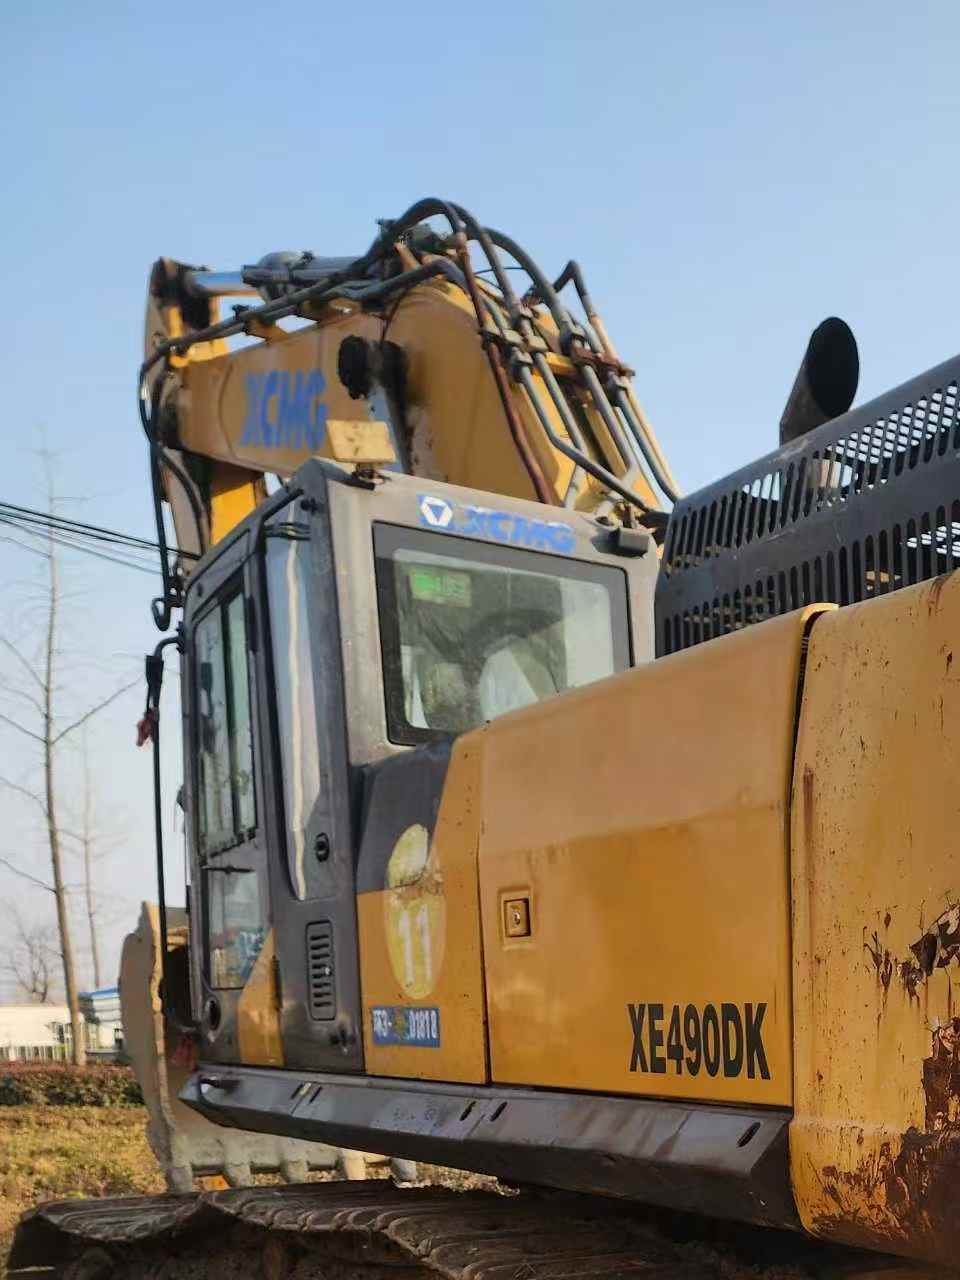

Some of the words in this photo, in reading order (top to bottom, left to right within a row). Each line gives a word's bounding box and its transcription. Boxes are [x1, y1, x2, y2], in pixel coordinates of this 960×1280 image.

[241, 369, 327, 450] XCMG
[463, 506, 577, 555] XCMG
[627, 1002, 771, 1080] XE490DK
